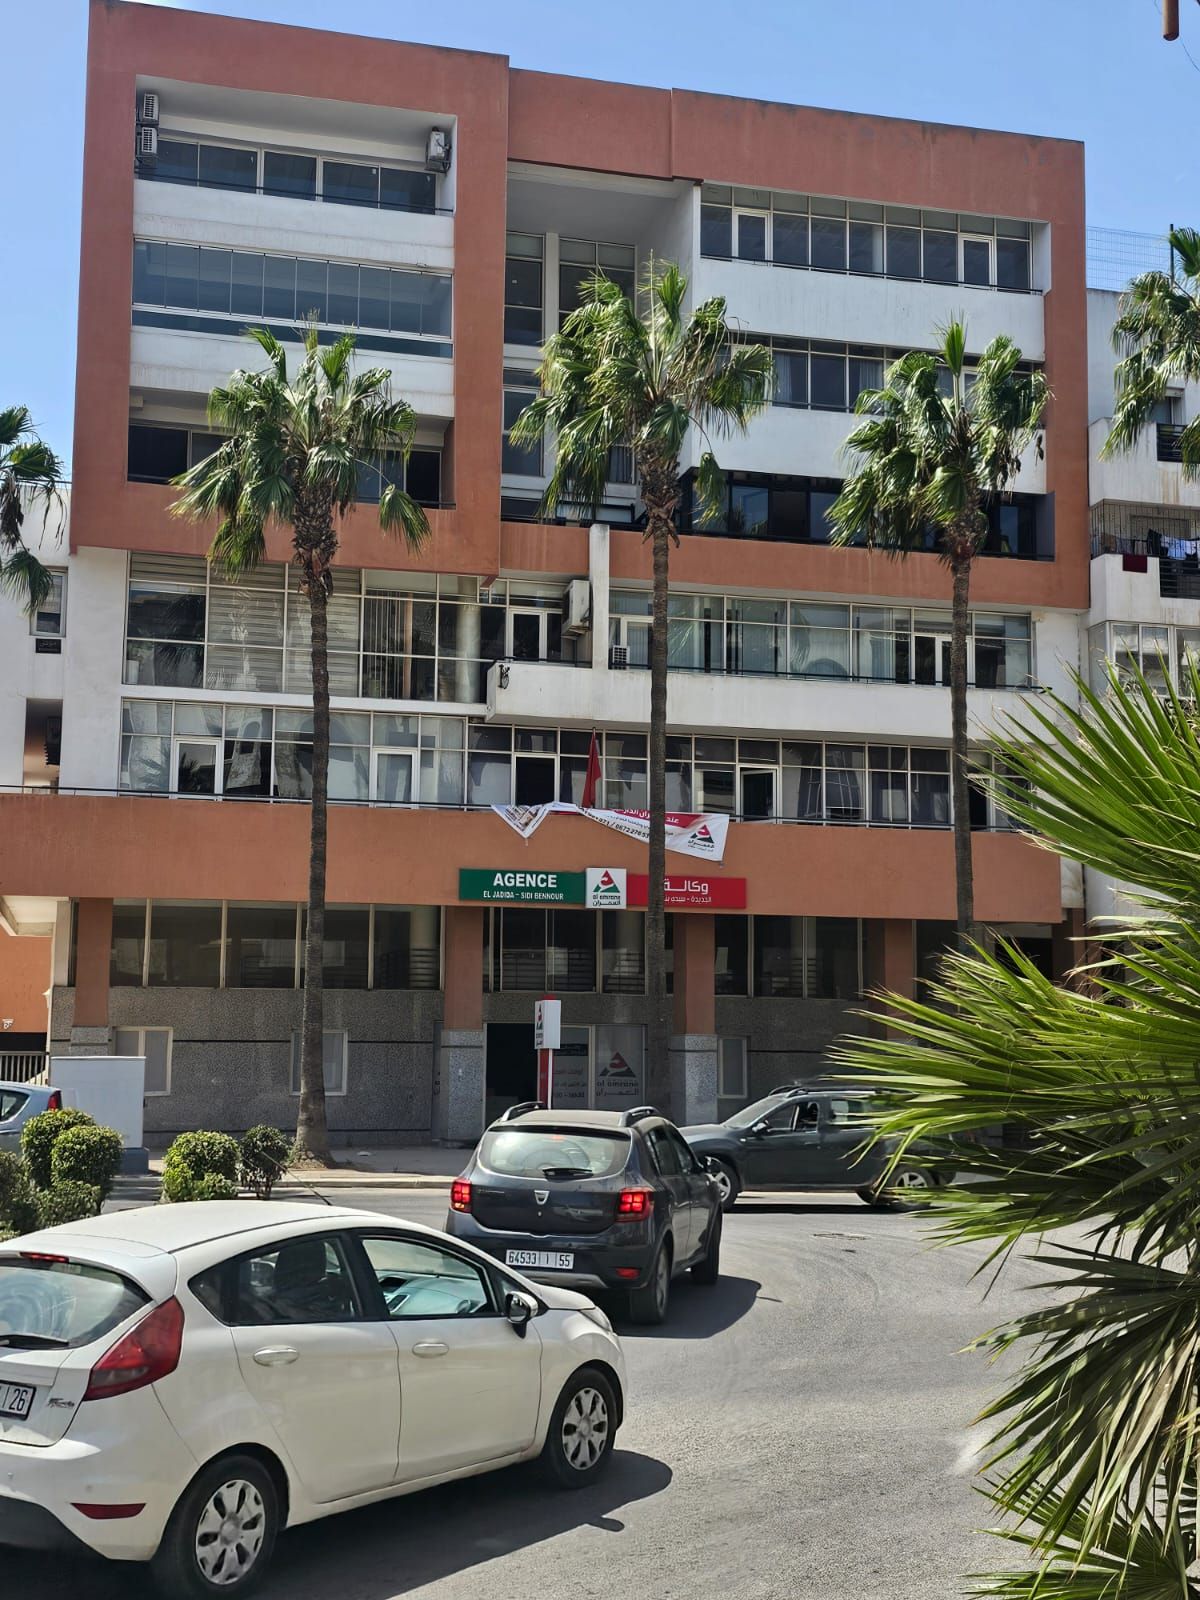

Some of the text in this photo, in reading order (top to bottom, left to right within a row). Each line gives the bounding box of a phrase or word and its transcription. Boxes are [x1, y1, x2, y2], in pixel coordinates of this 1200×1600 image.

[493, 872, 557, 888] AGENCE
[483, 890, 491, 898] EL
[493, 890, 515, 899] JADIDA
[521, 891, 533, 899] SIDI
[534, 892, 564, 900] BENNOUR
[508, 1251, 537, 1265] 64533
[559, 1254, 570, 1267] 55
[9, 1388, 28, 1411] 26
